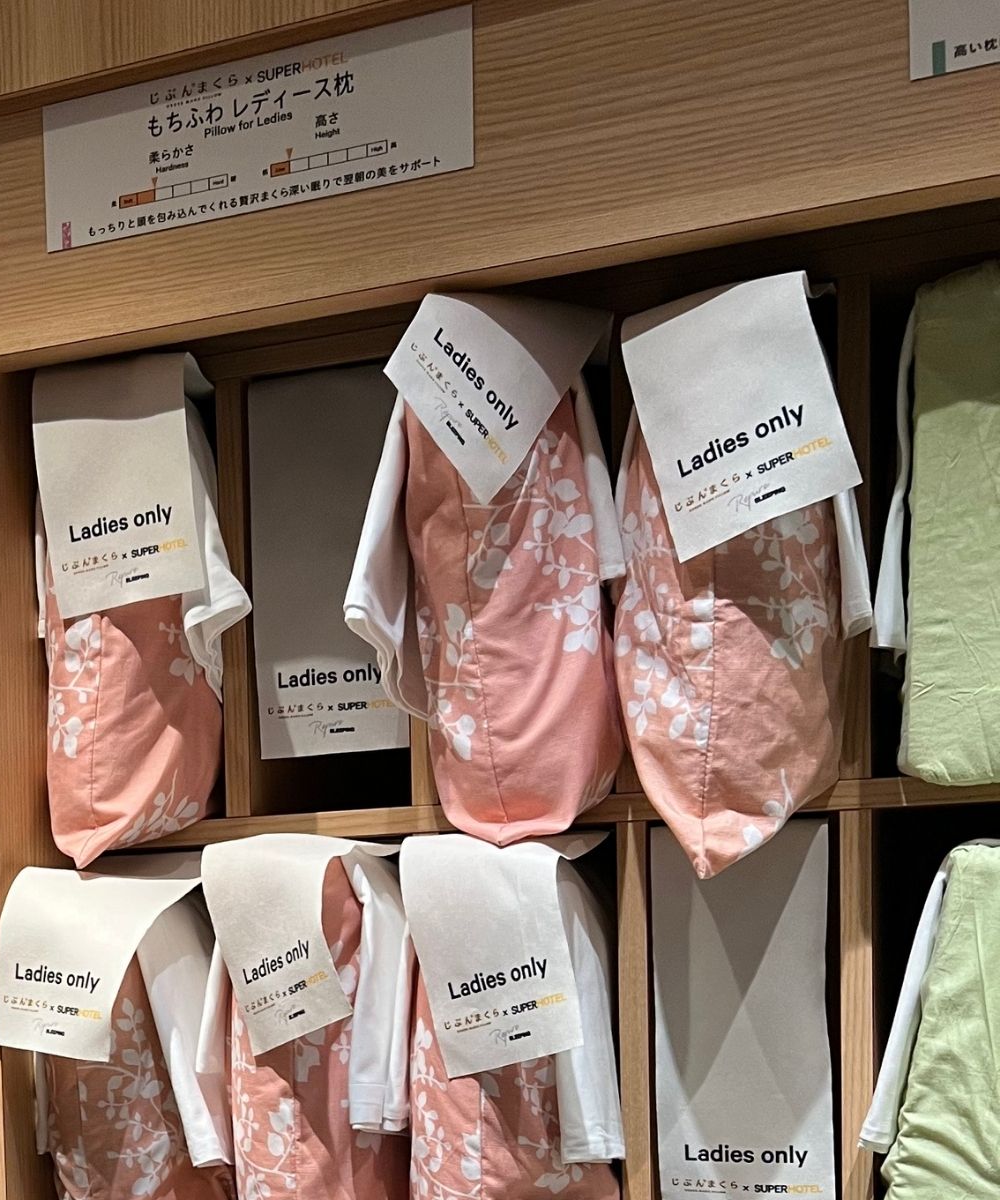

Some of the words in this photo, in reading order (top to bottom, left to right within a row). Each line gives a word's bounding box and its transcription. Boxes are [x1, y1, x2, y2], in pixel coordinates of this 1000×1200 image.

[148, 103, 223, 137] もちふわ
[233, 70, 354, 119] レディース枕
[204, 125, 235, 138] Pillow
[239, 118, 254, 131] for
[257, 111, 293, 127] Ledies
[315, 112, 339, 128] 高さ
[315, 127, 341, 139] Height
[149, 144, 194, 164] 柔らかさ
[155, 161, 189, 174] Hardness
[433, 327, 485, 390] Ladies
[486, 390, 519, 430] only
[677, 431, 749, 478] Ladies
[755, 404, 803, 439] only
[757, 436, 832, 474] SUPERHOTEL
[69, 516, 129, 542] Ladies
[133, 504, 172, 527] only
[278, 668, 337, 689] Ladies
[343, 663, 381, 684] only
[338, 699, 393, 711] SUPERHOTE
[243, 956, 284, 985] Ladies
[285, 939, 309, 965] only
[15, 963, 63, 985] Ladies
[66, 971, 101, 994] only
[448, 972, 506, 1000] Ladies
[510, 956, 547, 983] only
[684, 1144, 755, 1164] Ladies
[761, 1145, 808, 1168] only
[754, 1184, 823, 1194] SUPERHOTEL
